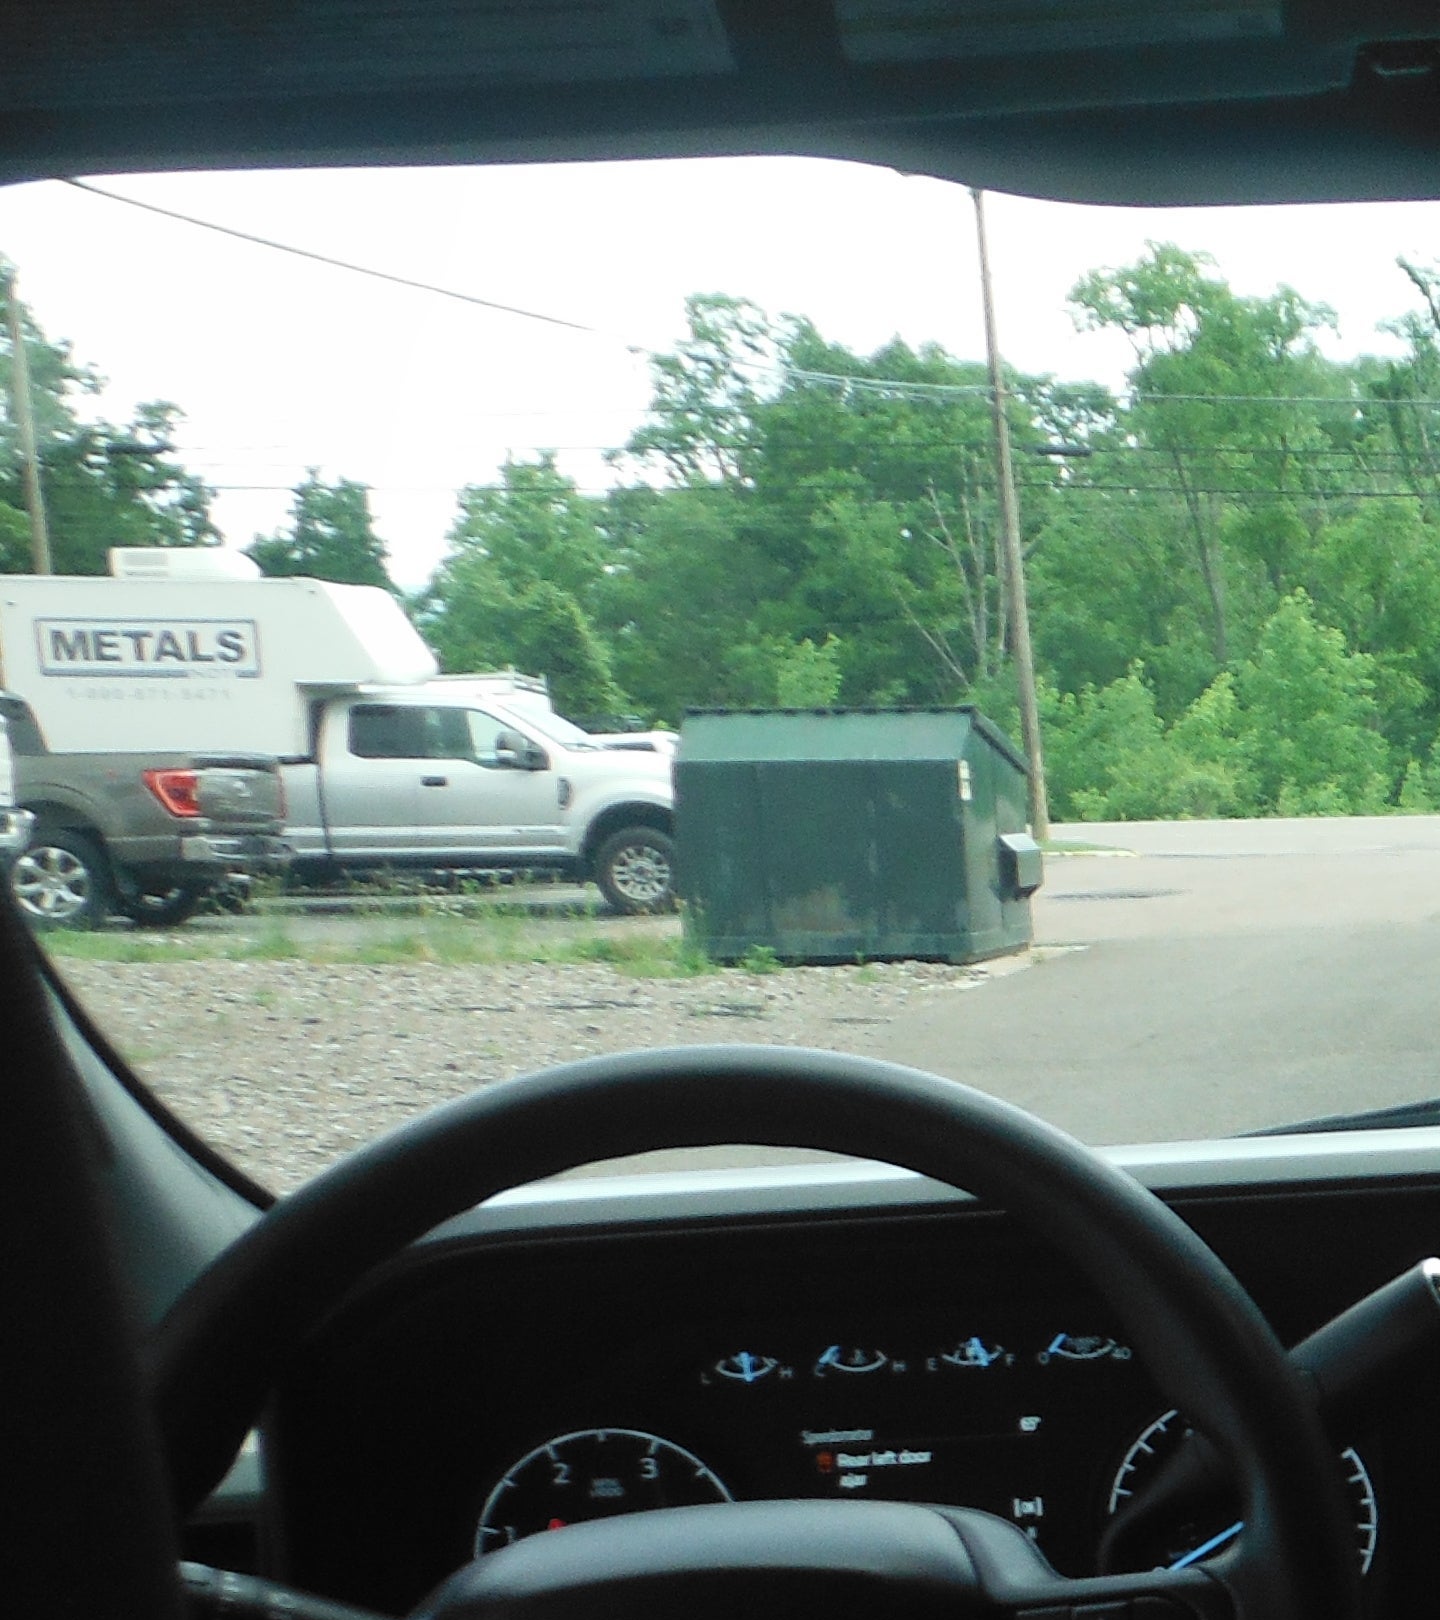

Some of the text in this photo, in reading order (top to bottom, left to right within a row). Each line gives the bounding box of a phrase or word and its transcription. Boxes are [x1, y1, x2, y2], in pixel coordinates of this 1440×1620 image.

[50, 629, 247, 662] METALS
[553, 1462, 573, 1485] 2
[640, 1456, 660, 1480] 3
